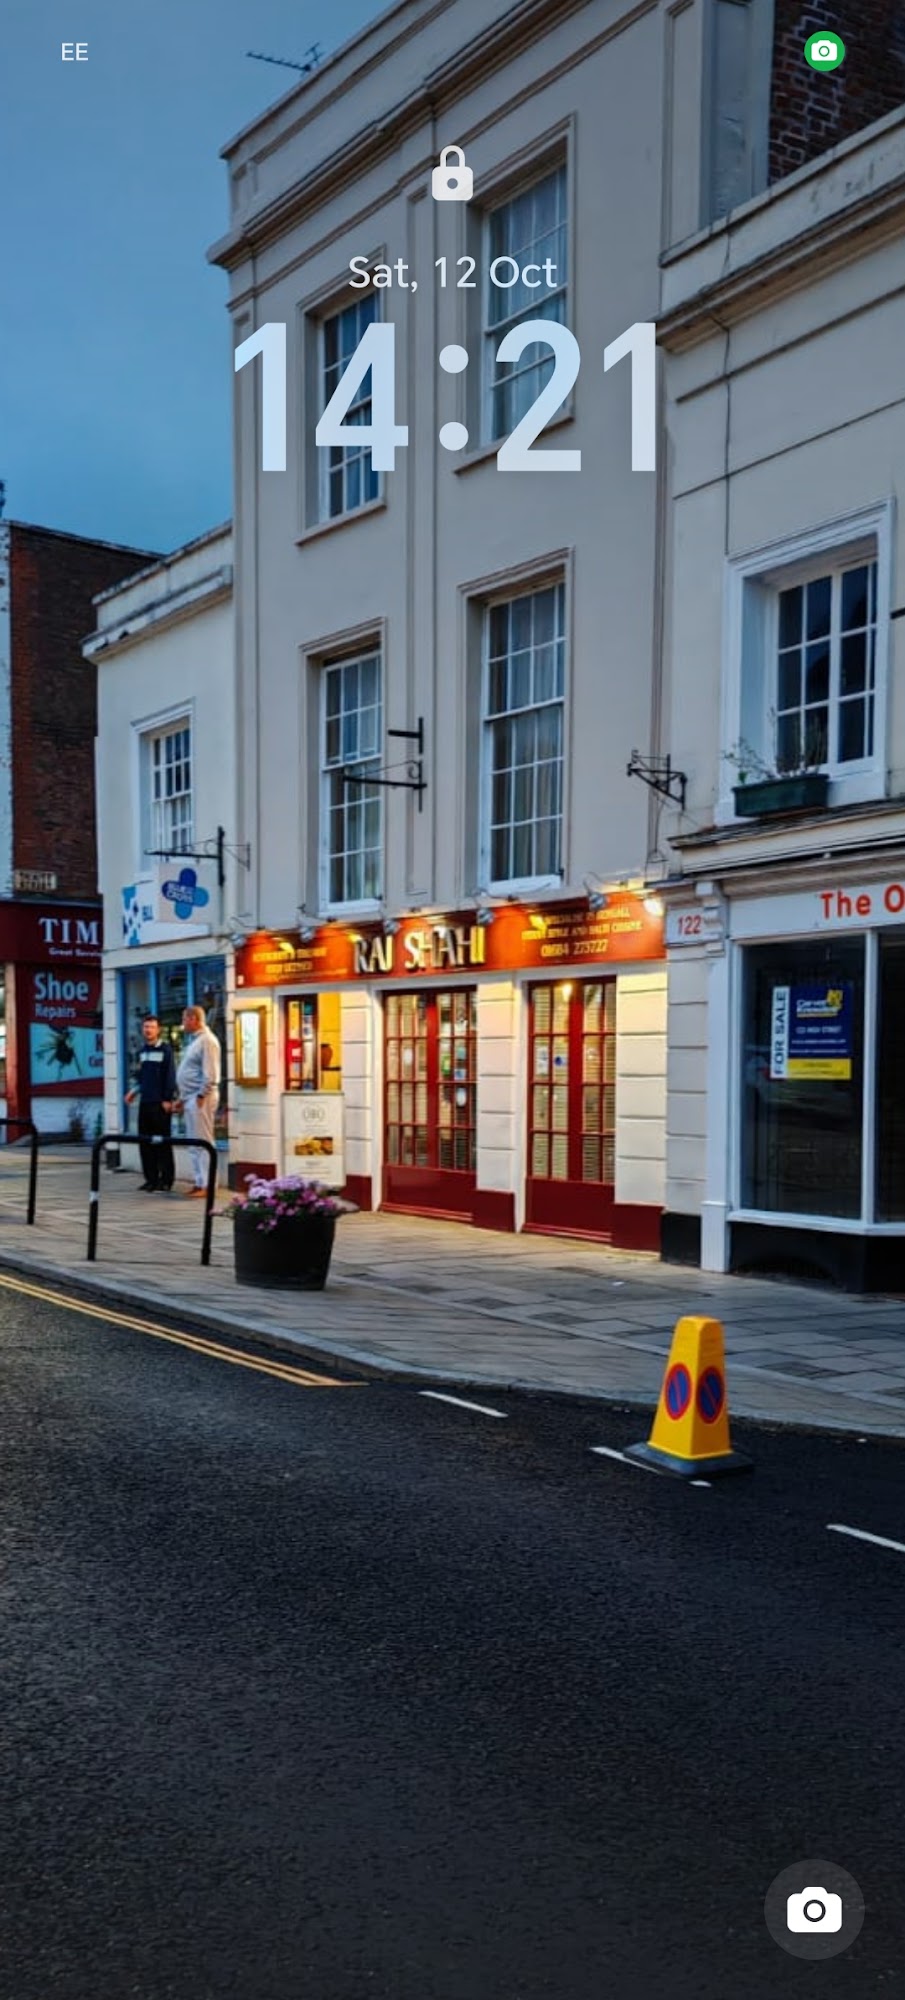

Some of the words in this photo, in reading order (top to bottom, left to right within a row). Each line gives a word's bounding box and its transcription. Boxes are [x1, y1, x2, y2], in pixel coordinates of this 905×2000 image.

[166, 890, 194, 903] CROSS
[820, 891, 873, 920] The
[677, 914, 702, 935] 122
[353, 934, 394, 974] RAJ
[403, 924, 486, 970] SHAHI
[34, 971, 89, 1001] Shoe
[35, 1003, 76, 1020] Repairs
[775, 990, 787, 1035] SALE
[774, 1040, 786, 1075] FOR
